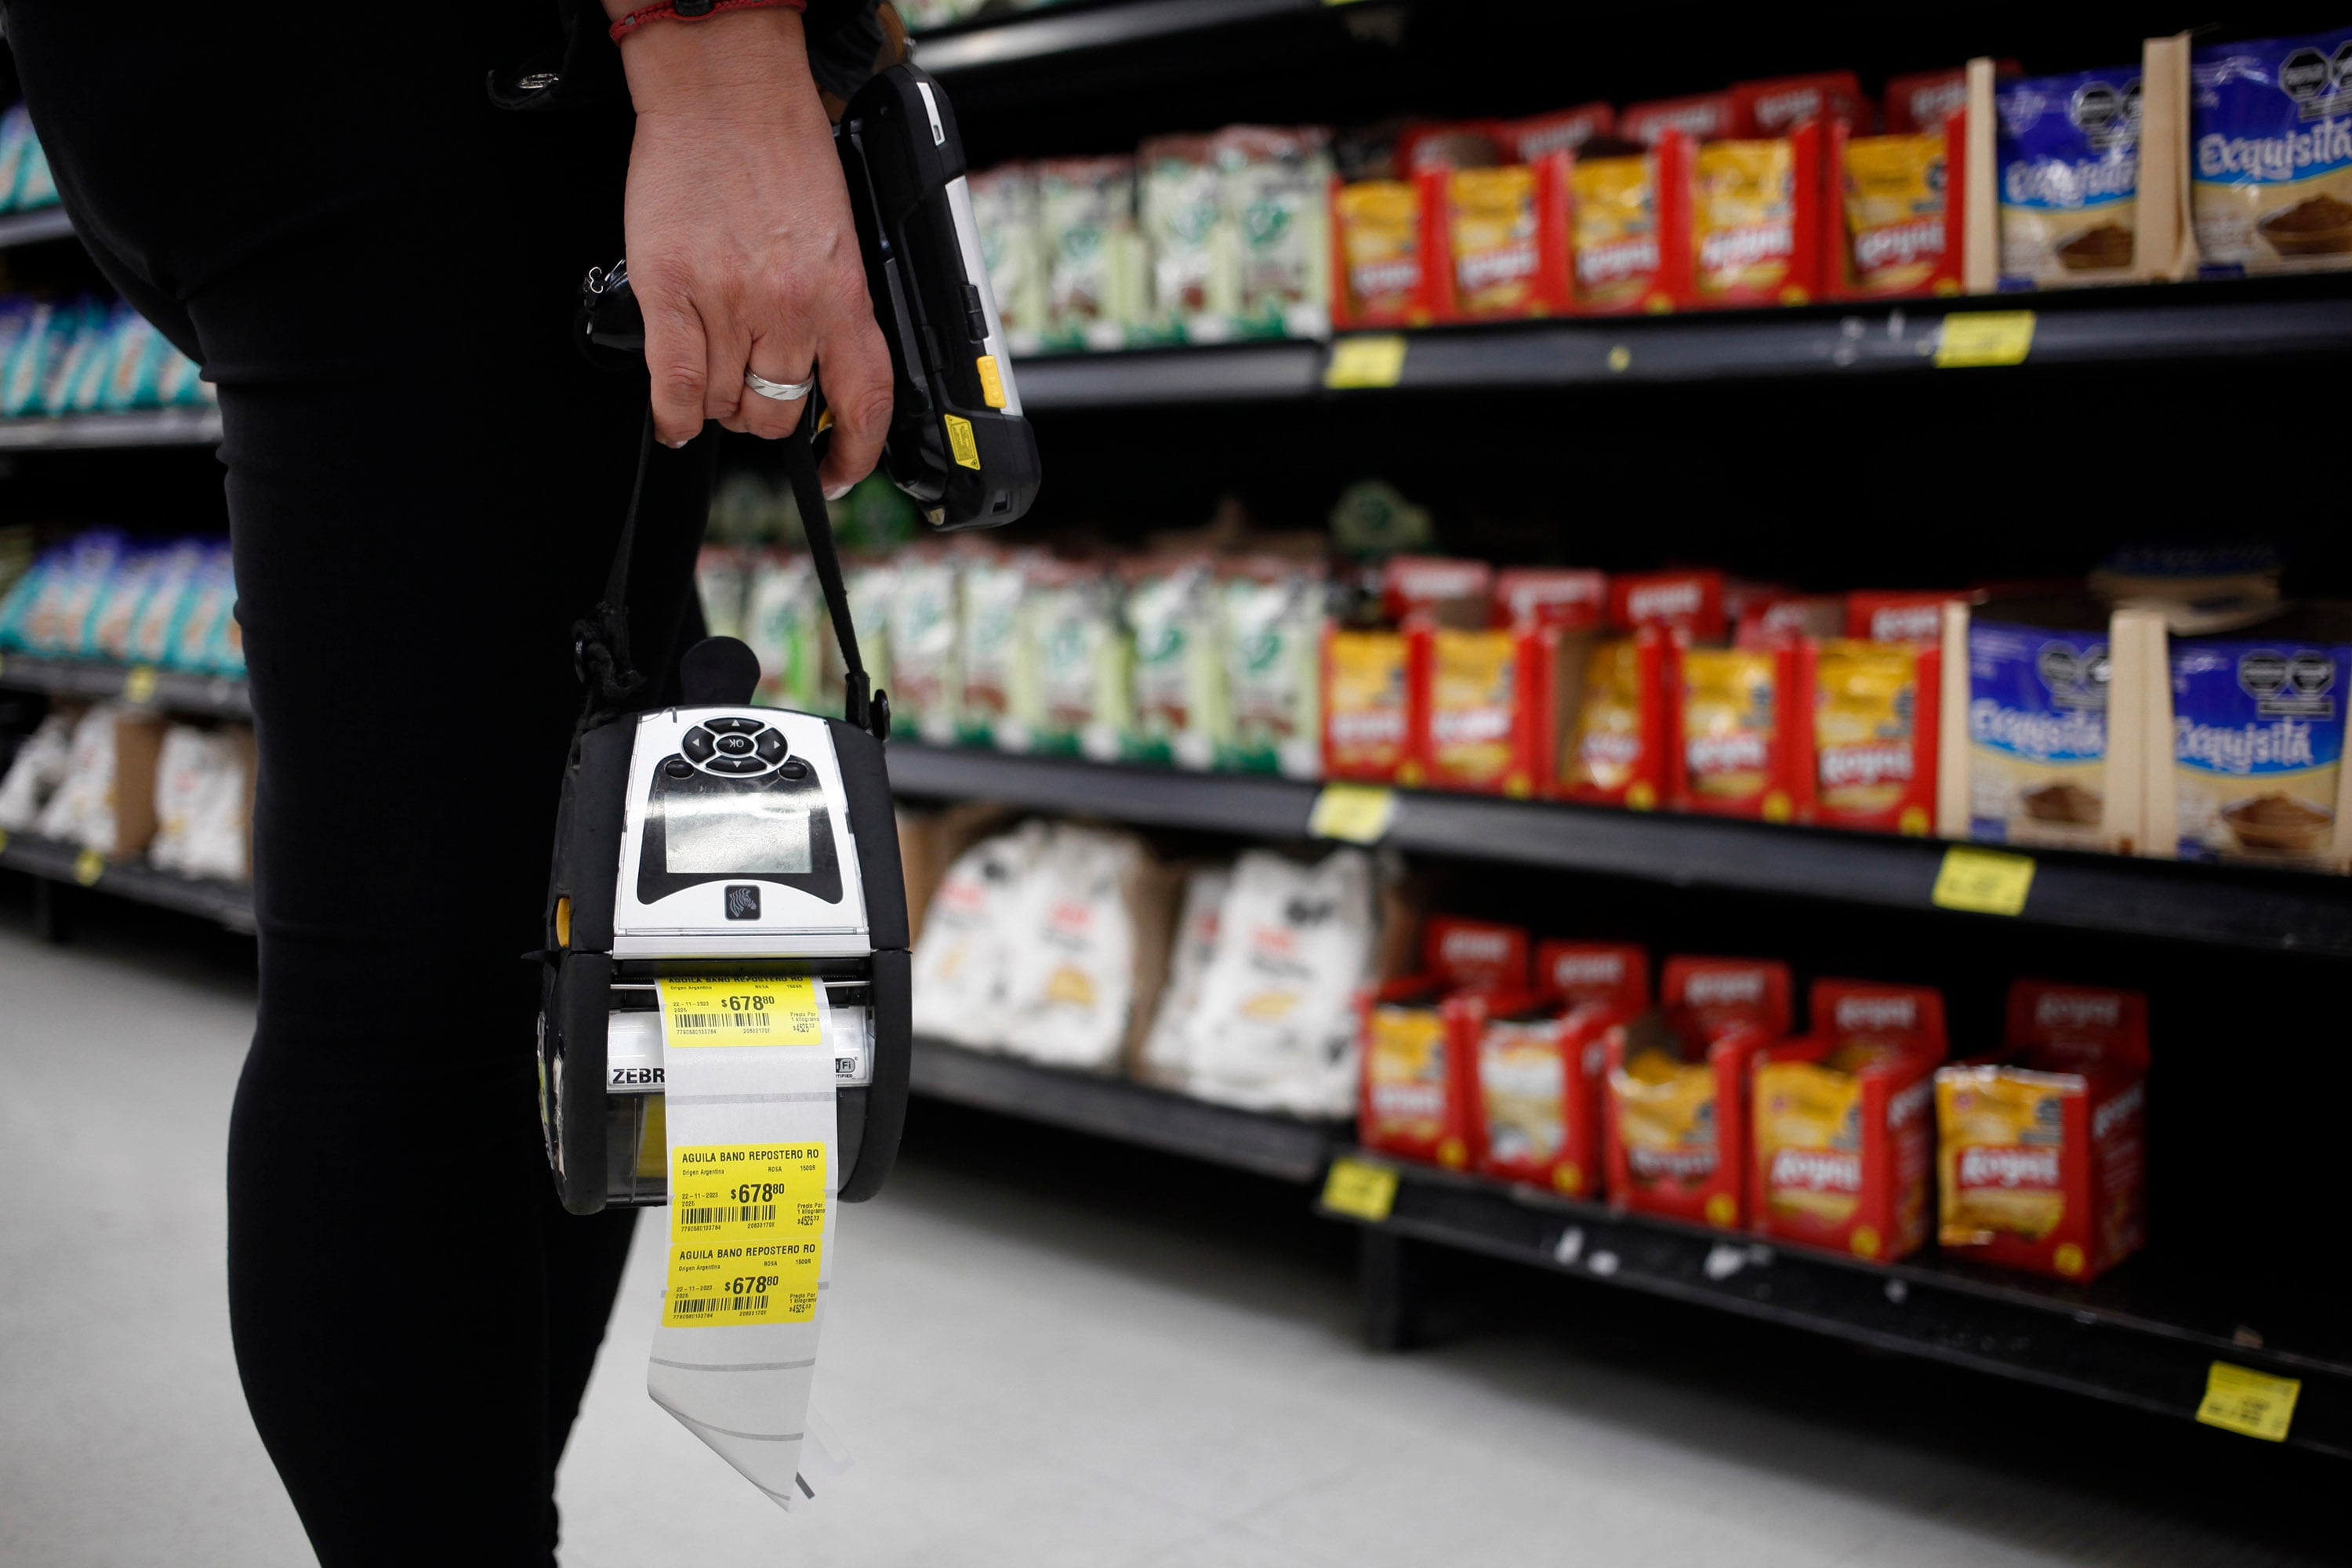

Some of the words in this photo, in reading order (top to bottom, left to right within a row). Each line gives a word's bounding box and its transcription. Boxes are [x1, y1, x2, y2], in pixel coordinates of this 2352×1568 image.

[728, 739, 745, 748] OK
[613, 1068, 665, 1084] ZEBR
[682, 1152, 717, 1163] AGUILA
[720, 1151, 746, 1162] BANO
[750, 1149, 803, 1161] REPOSTERO
[807, 1149, 819, 1159] RO
[679, 1250, 713, 1261] AGUILA
[717, 1248, 742, 1258] BANO
[746, 1245, 800, 1256] REPOSTERO
[803, 1244, 815, 1254] RO
